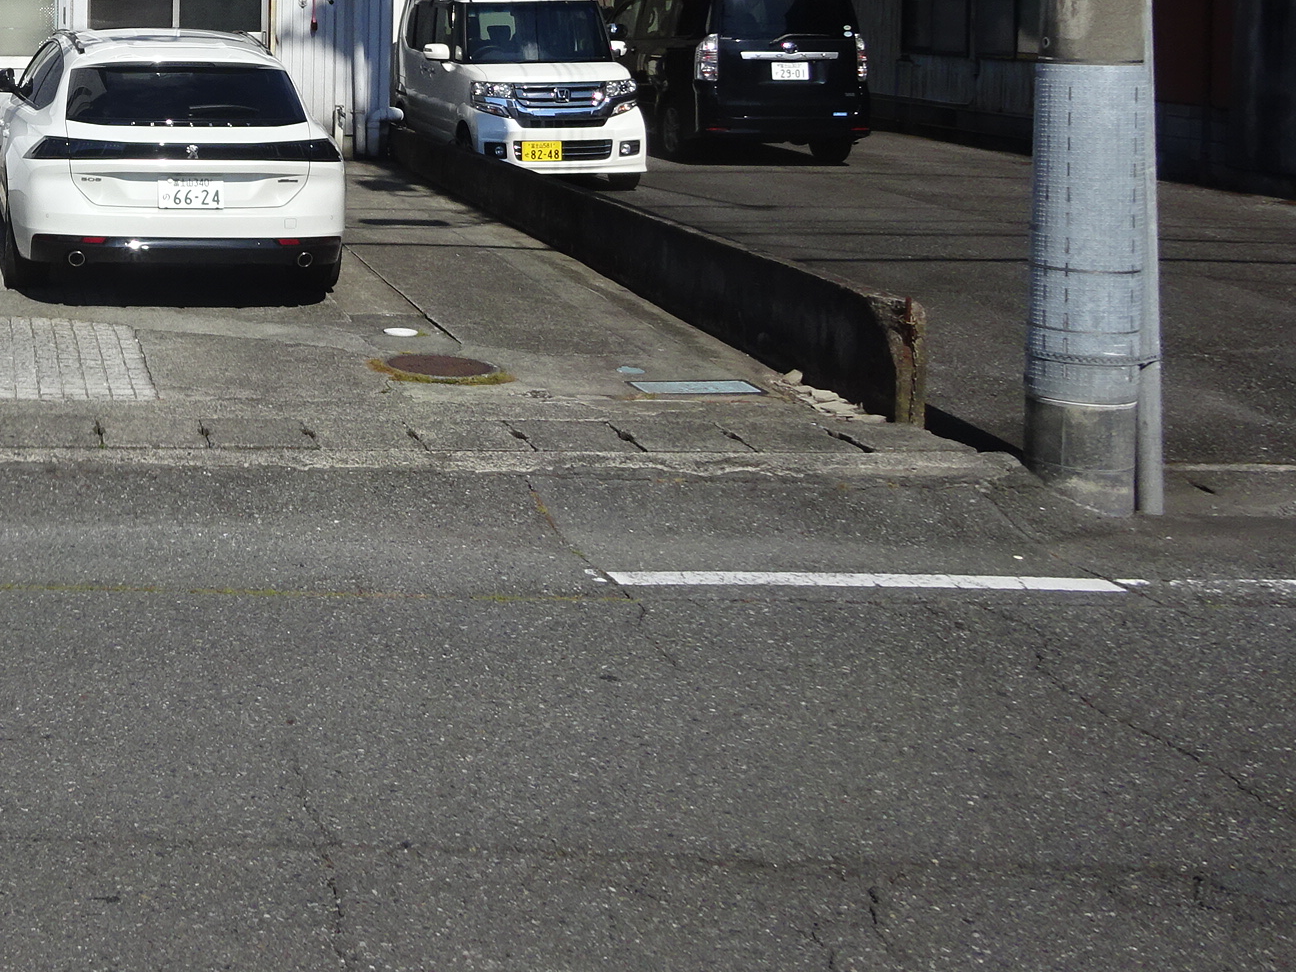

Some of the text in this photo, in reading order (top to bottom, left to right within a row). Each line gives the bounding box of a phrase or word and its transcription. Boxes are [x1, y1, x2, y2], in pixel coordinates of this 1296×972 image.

[780, 69, 805, 78] 29-01
[530, 149, 559, 160] 82-48
[162, 189, 220, 205] の 66-24
